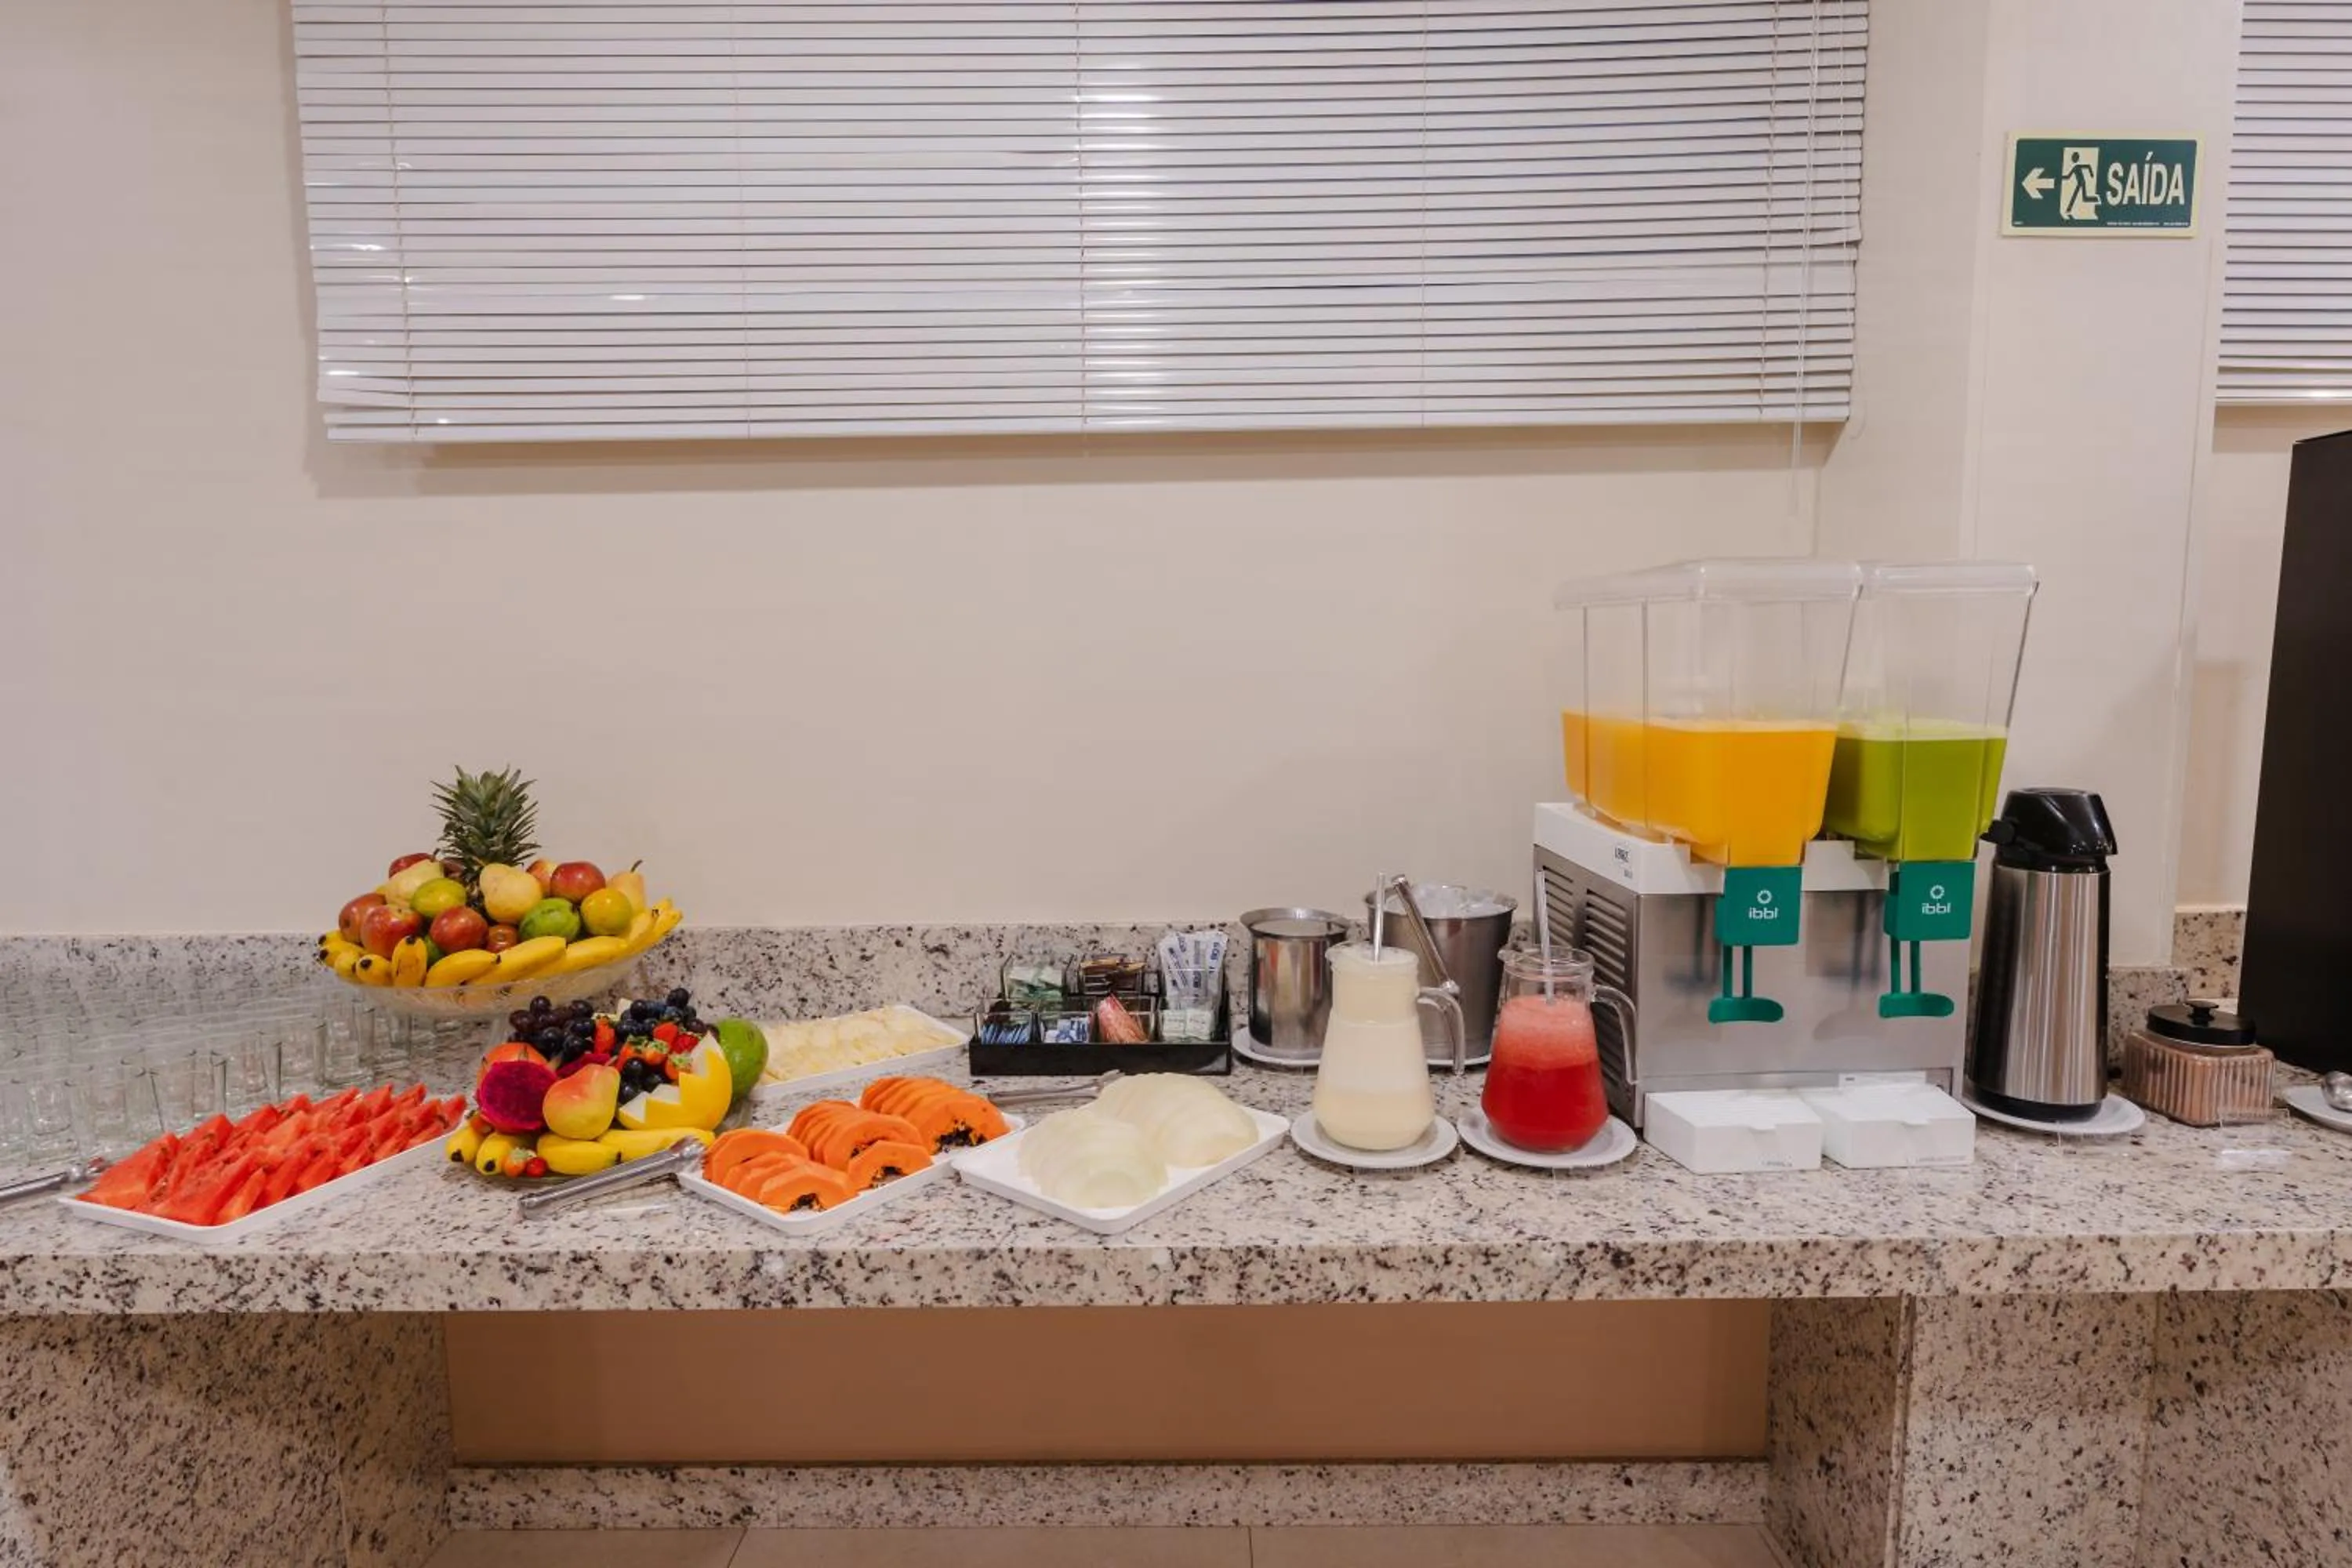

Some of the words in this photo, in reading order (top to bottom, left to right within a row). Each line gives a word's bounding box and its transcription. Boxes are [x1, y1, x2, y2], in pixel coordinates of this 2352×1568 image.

[2106, 151, 2185, 205] SAÍDA
[1748, 906, 1778, 920] ibbl
[1922, 902, 1951, 915] ibbl
